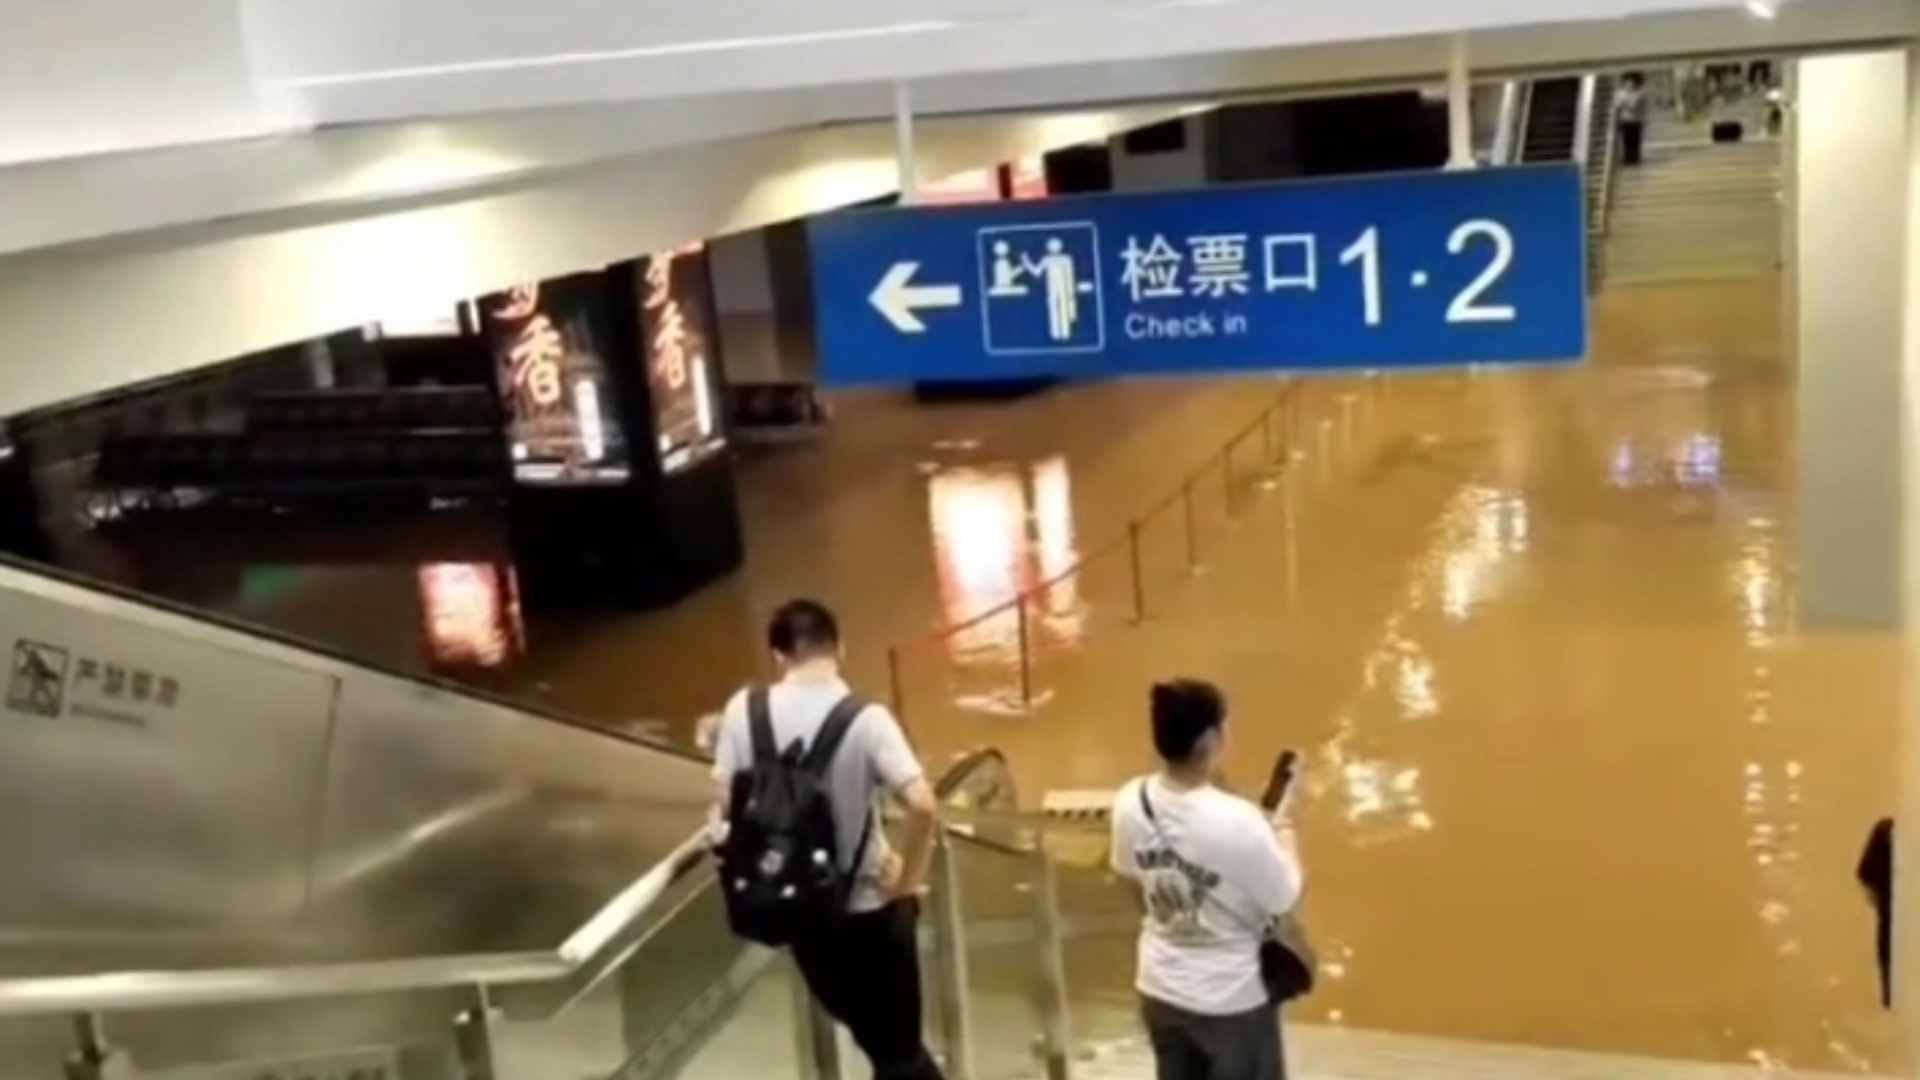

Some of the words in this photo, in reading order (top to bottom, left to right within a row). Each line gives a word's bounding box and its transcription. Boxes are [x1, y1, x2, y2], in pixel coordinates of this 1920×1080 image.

[1120, 233, 1318, 302] 检票口
[1124, 311, 1214, 340] Check
[1223, 311, 1248, 334] in
